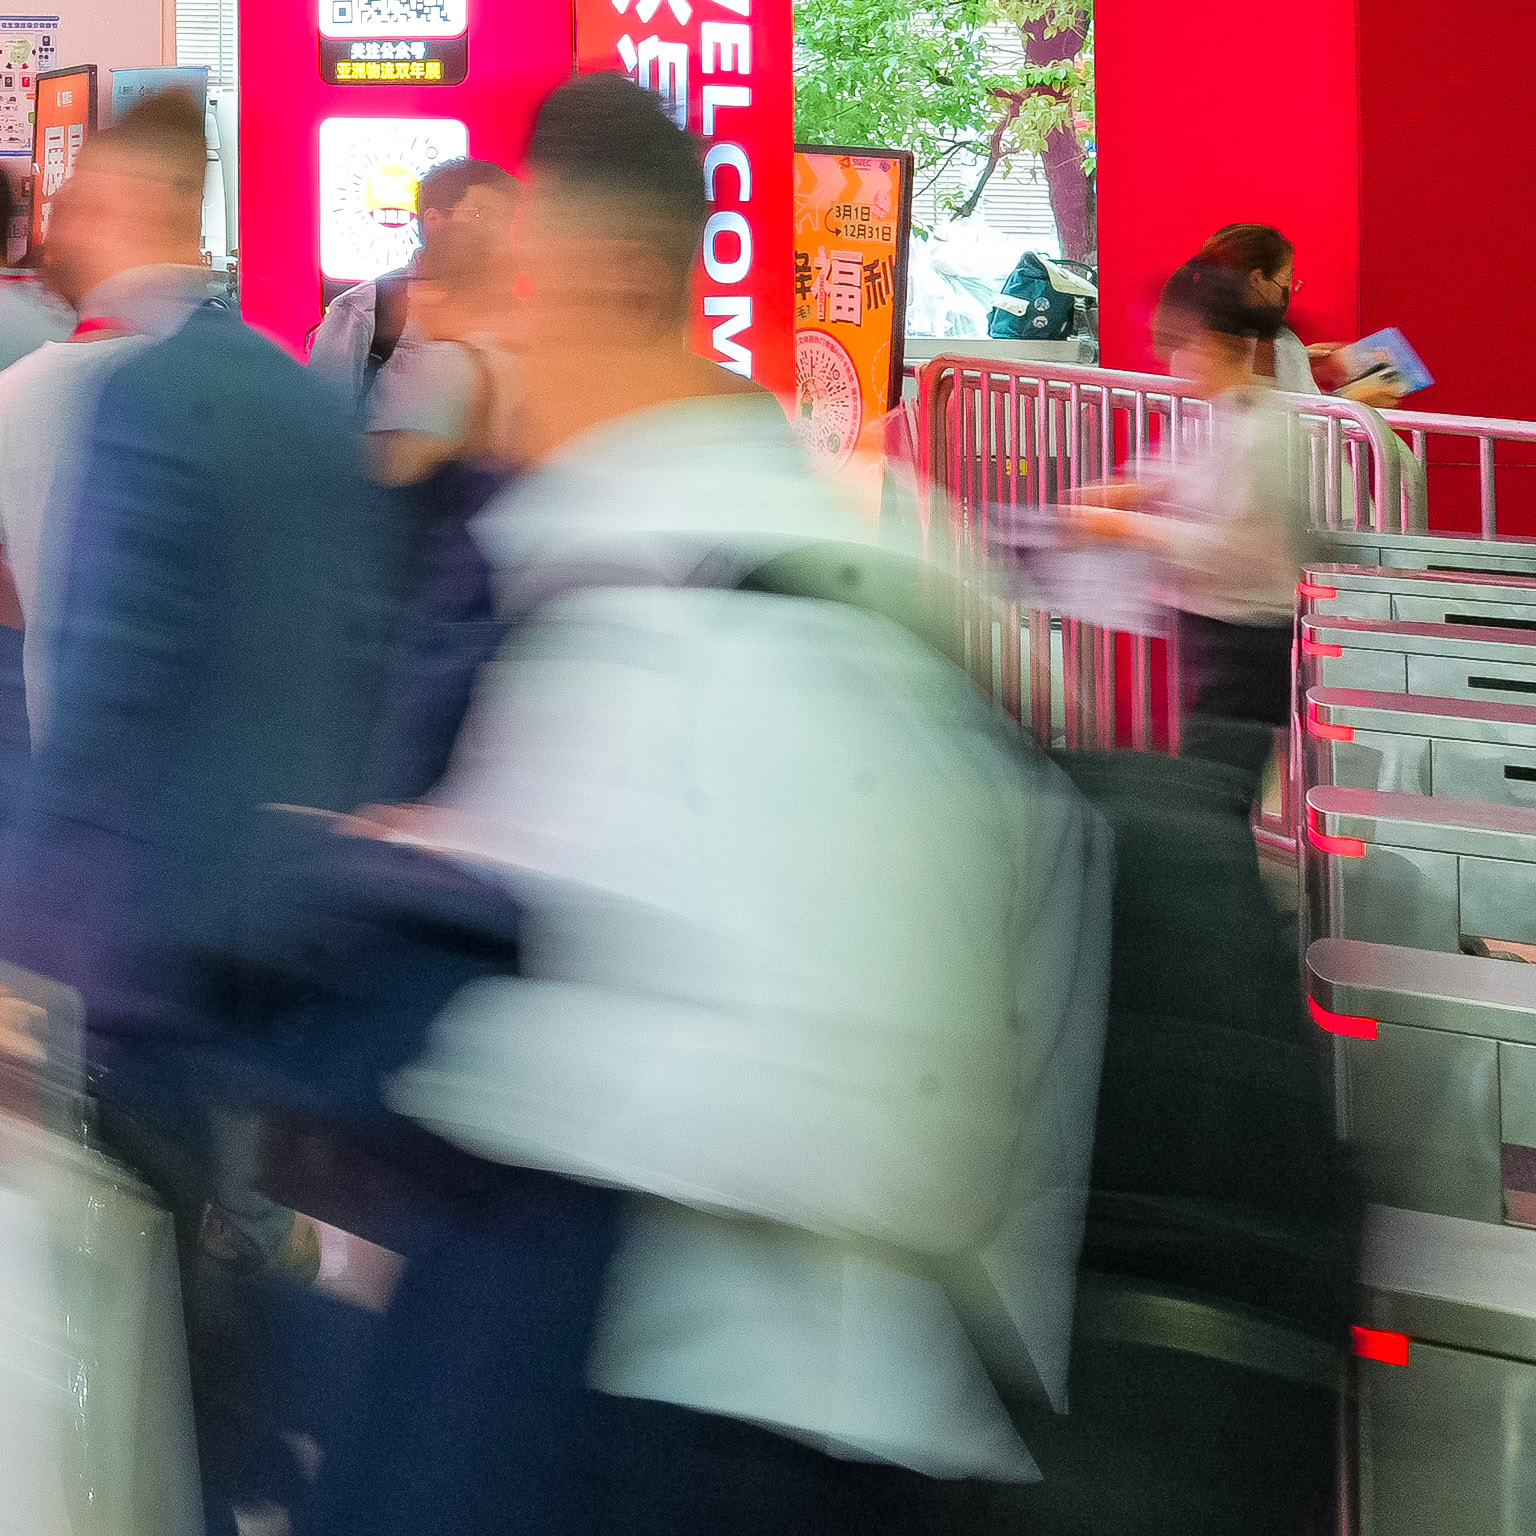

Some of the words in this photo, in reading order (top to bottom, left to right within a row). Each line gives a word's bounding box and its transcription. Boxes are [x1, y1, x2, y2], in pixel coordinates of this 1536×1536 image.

[350, 41, 426, 60] 关注公众号
[336, 61, 442, 80] 亚洲物流双年展
[835, 204, 871, 222] 3月1日
[843, 223, 892, 242] 12月31日
